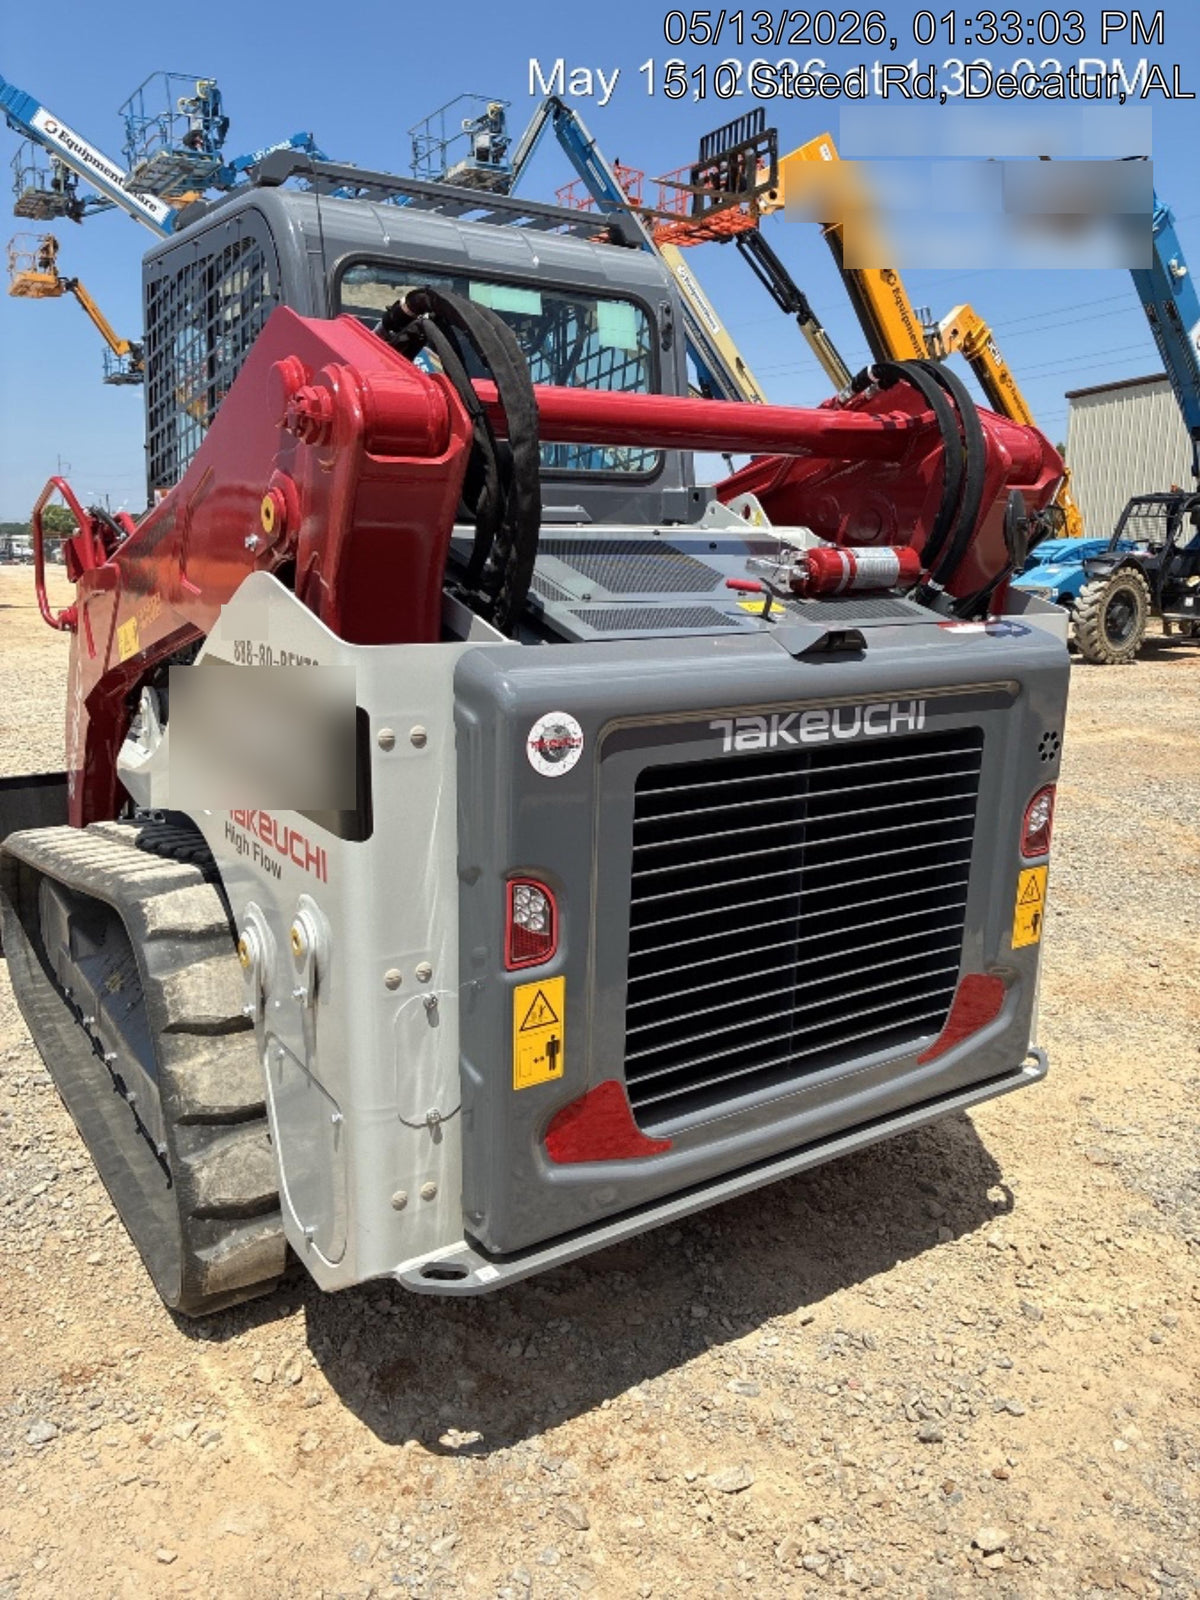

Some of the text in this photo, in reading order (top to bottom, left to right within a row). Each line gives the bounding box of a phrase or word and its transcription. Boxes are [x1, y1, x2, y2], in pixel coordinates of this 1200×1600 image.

[57, 129, 158, 213] Equipmentare
[224, 820, 282, 880] High Flow
